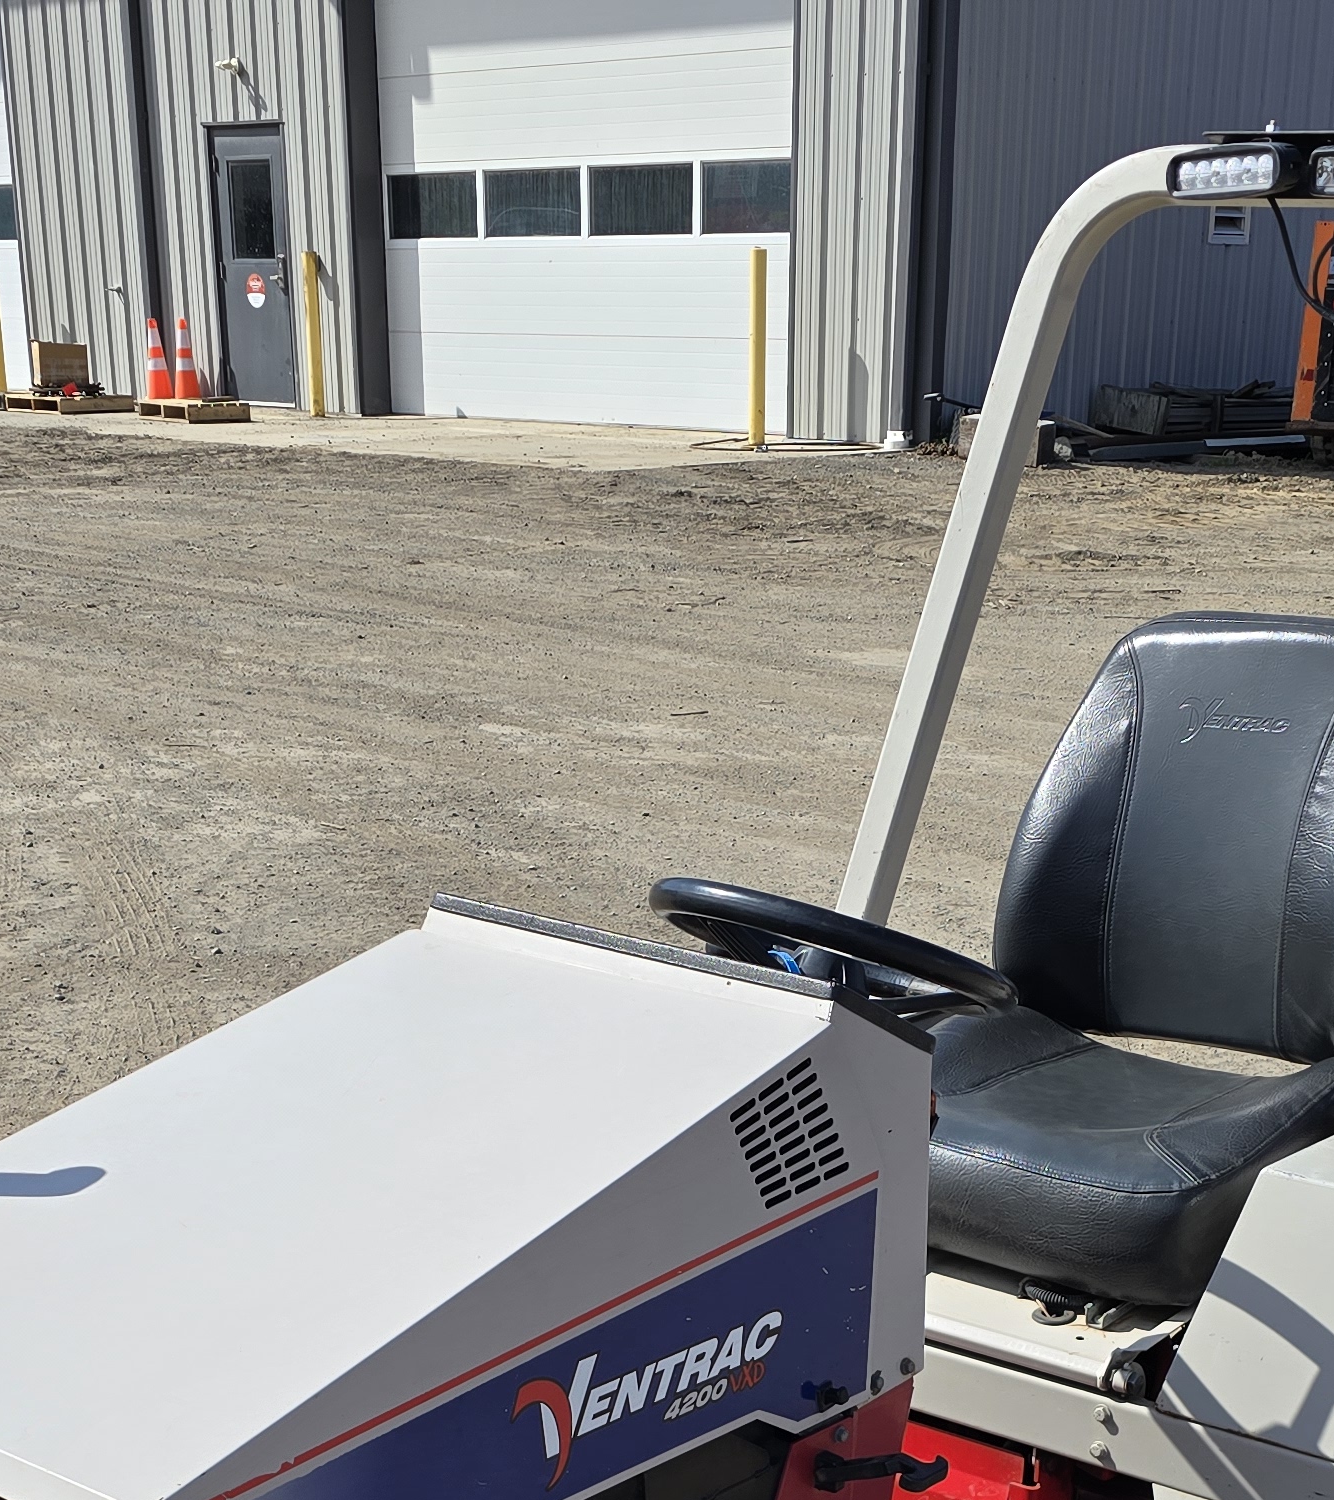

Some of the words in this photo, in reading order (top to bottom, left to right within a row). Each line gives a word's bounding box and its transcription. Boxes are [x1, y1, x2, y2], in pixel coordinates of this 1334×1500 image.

[1178, 696, 1291, 744] VENTRAC
[510, 1309, 784, 1493] VENTRAC
[663, 1376, 729, 1421] 4200
[729, 1359, 765, 1393] VXD
